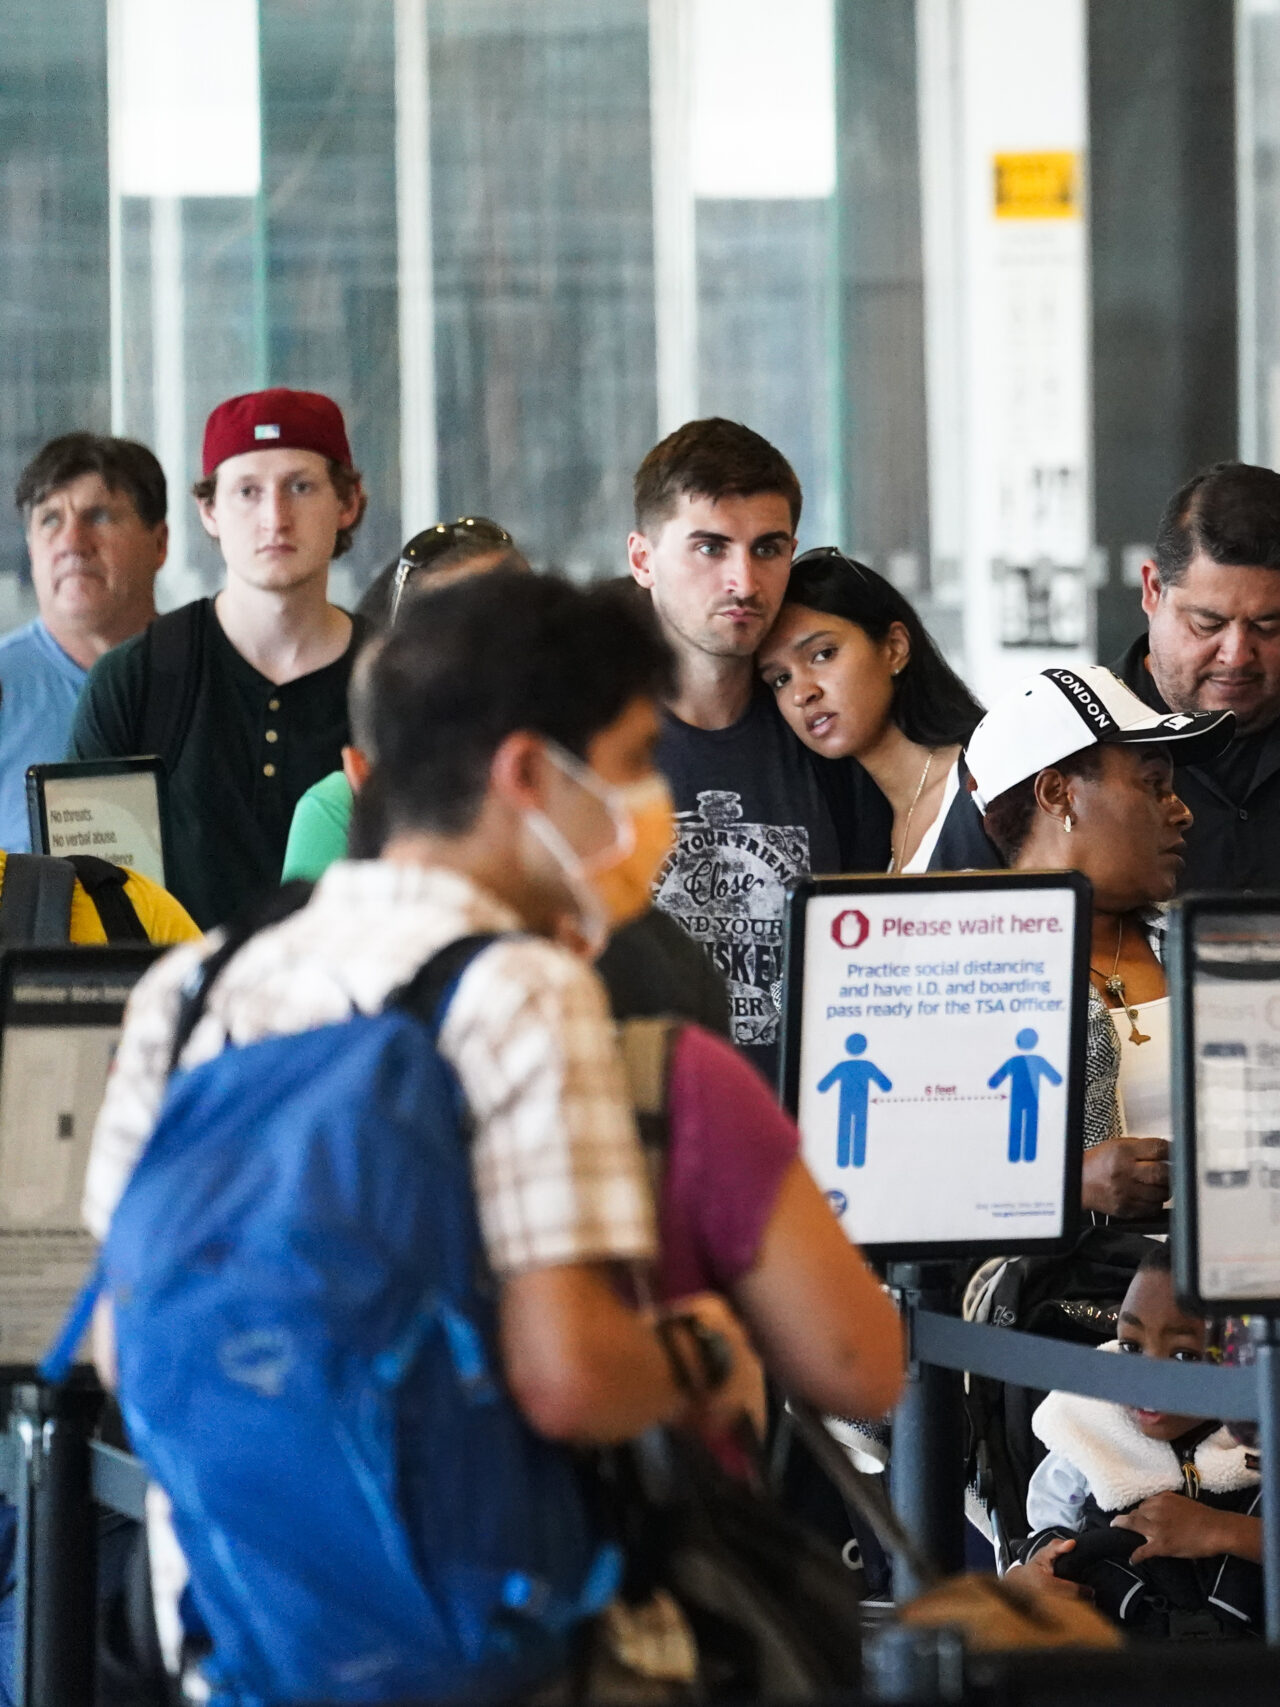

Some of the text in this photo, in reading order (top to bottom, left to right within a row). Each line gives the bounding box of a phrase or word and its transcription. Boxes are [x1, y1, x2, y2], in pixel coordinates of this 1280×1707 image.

[1052, 669, 1111, 730] LONDON
[50, 809, 62, 823] No
[52, 834, 64, 847] No
[678, 829, 730, 855] YOUR
[735, 833, 792, 881] FRIEN
[683, 859, 765, 907] Close
[679, 915, 783, 936] ND YOUR
[881, 914, 1064, 937] Please wait here.
[847, 959, 1045, 978] Practice social distancing
[838, 979, 1051, 998] and have I.D. and boarding
[826, 998, 1065, 1020] pass ready for the TSA Officer.
[924, 1085, 957, 1096] 6 feet
